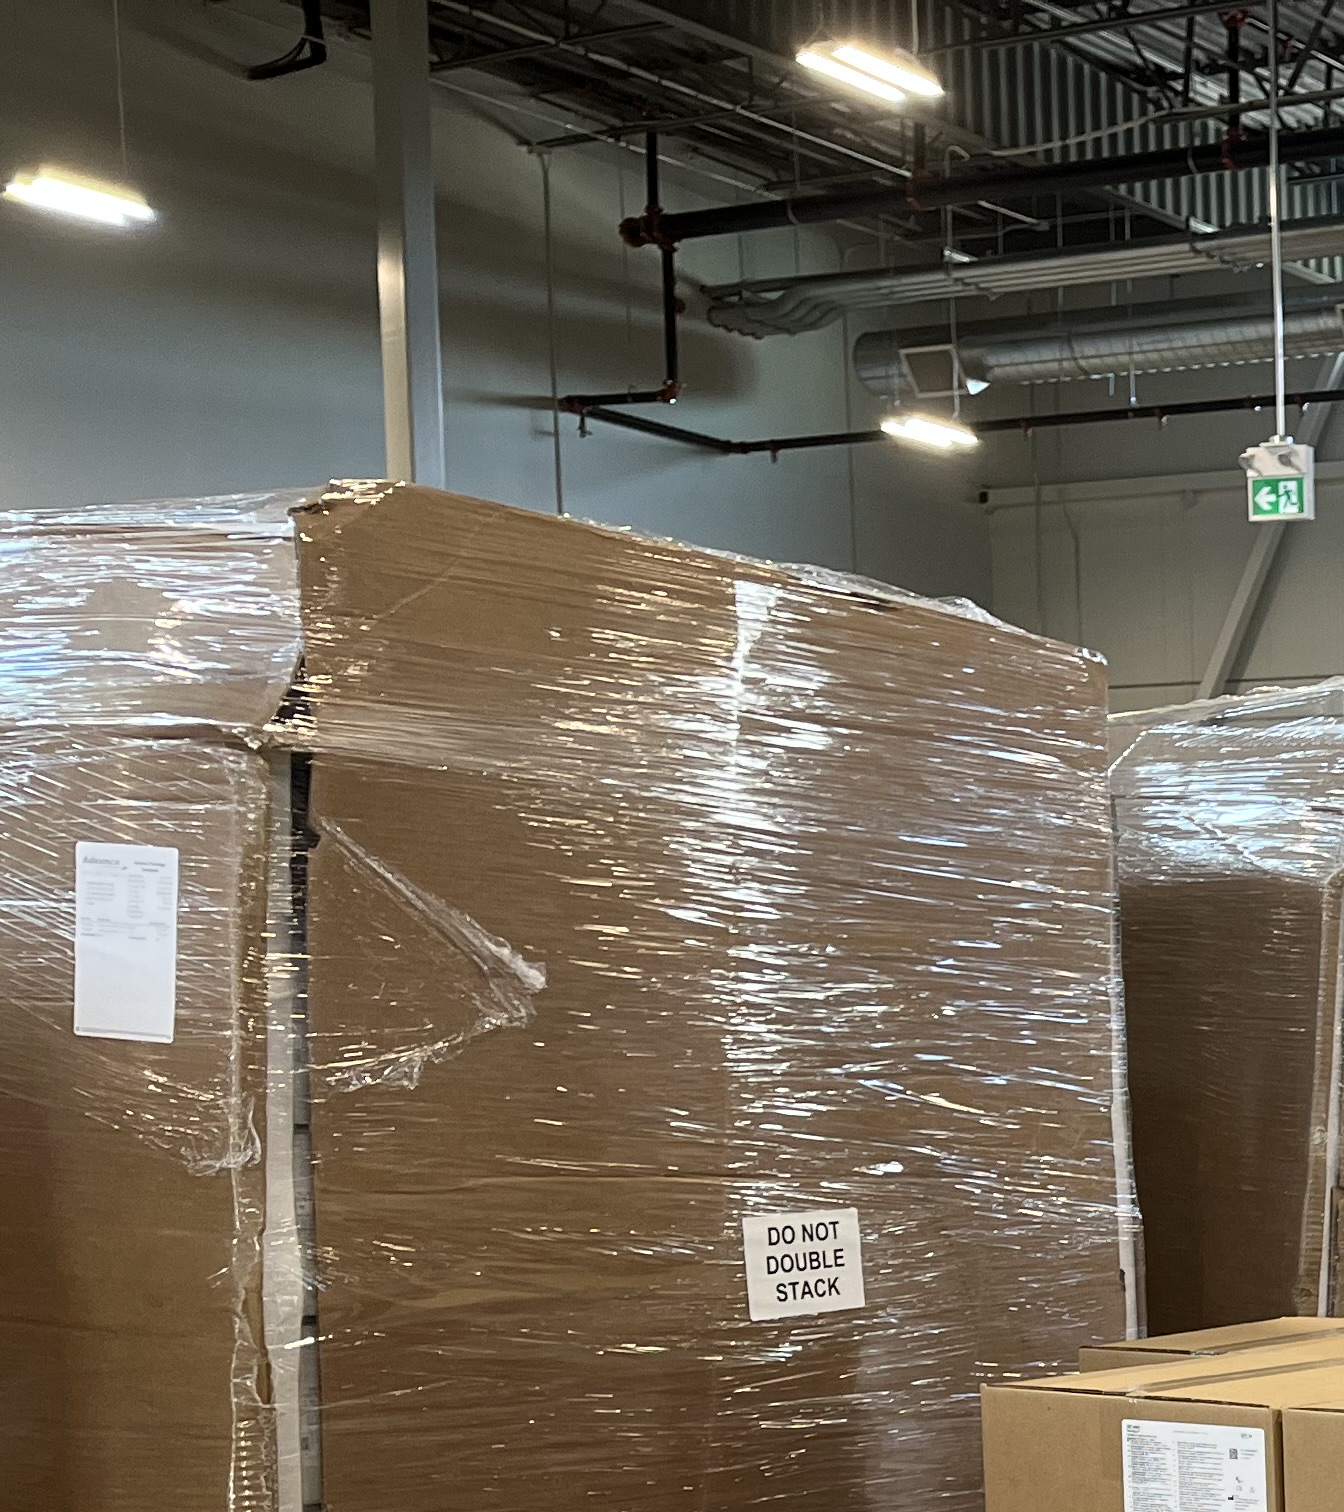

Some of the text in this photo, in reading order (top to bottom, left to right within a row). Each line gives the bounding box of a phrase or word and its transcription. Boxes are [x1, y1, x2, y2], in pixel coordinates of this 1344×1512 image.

[767, 1220, 840, 1246] DO NOT
[766, 1248, 846, 1275] DOUBLE
[776, 1276, 841, 1302] STACK
